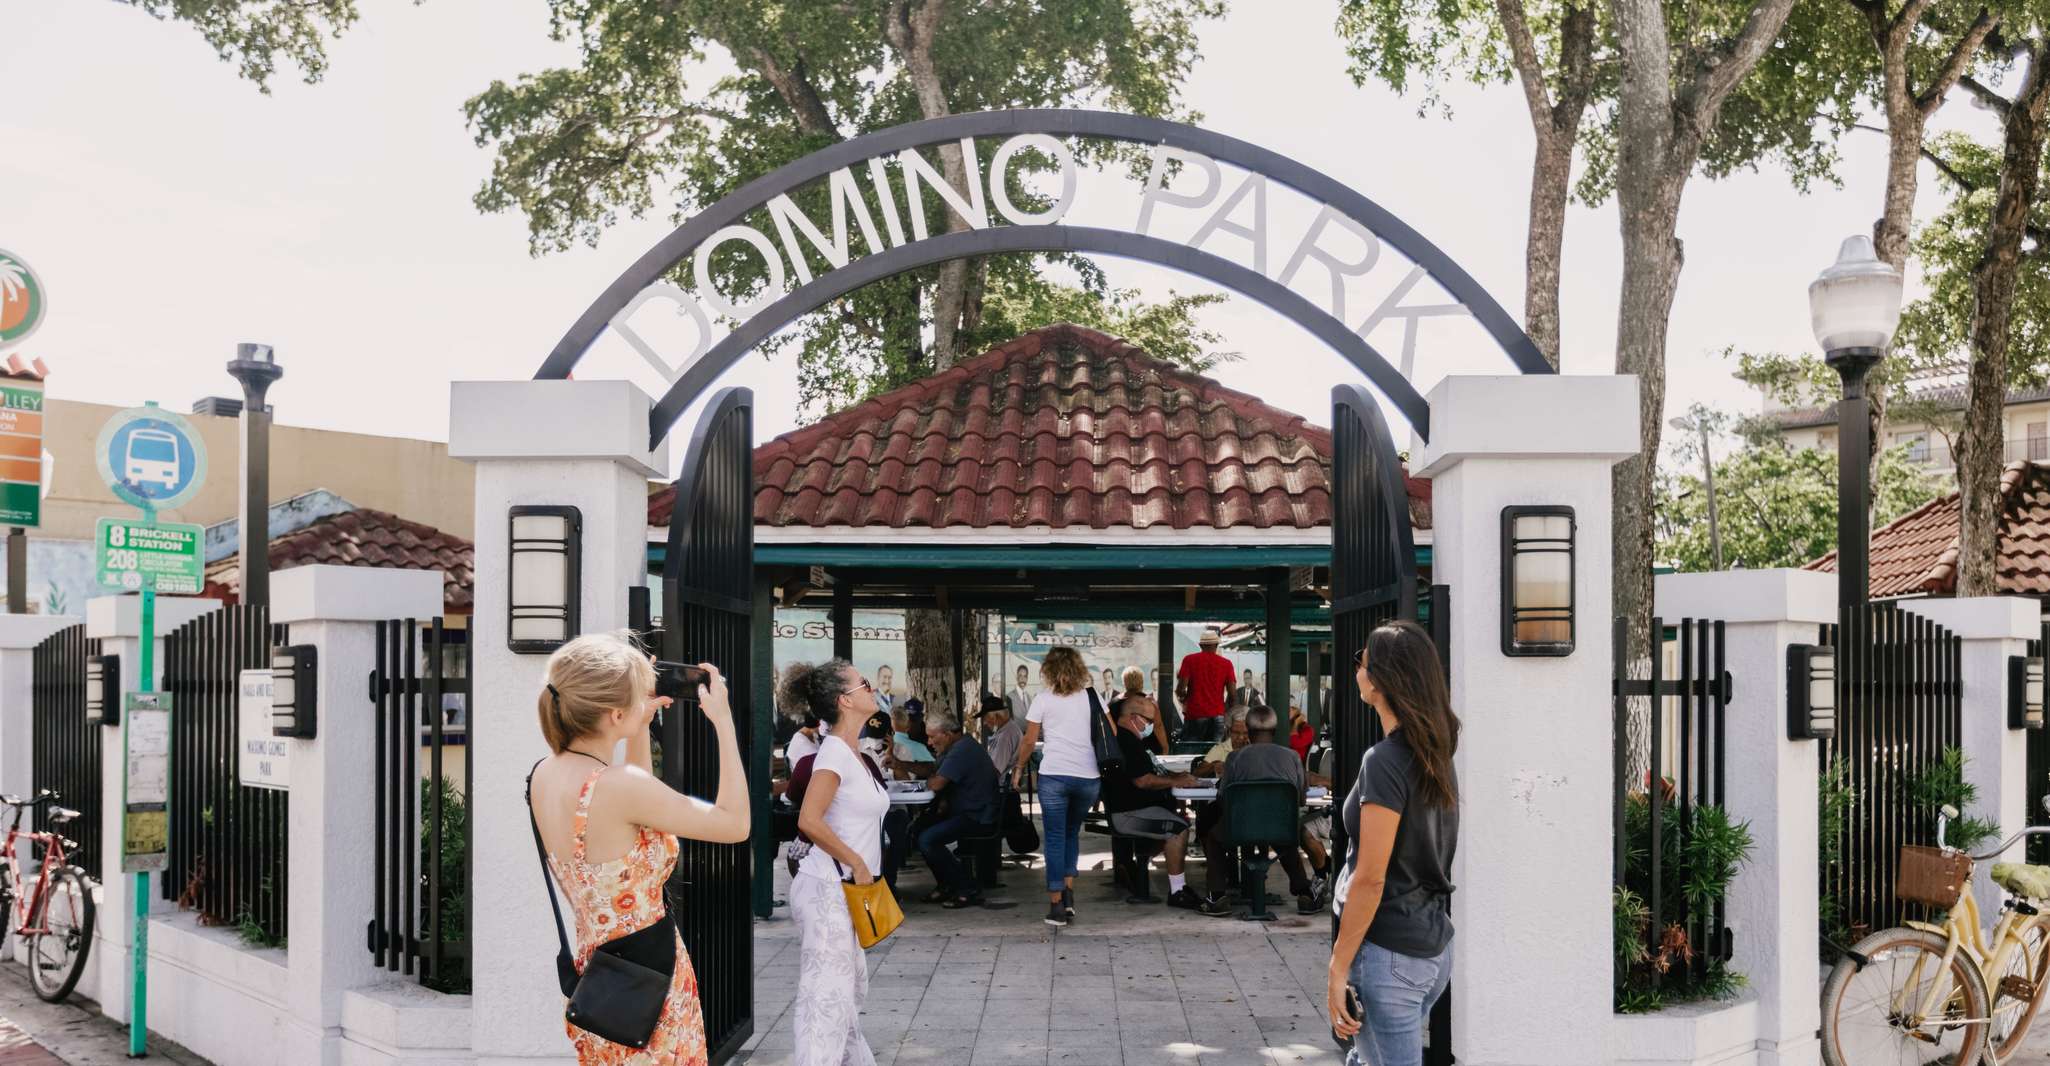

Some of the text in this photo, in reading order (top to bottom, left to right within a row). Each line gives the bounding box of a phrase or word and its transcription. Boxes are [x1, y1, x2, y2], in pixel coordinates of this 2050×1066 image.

[609, 132, 1474, 386] DOMINO PARK
[110, 526, 126, 546] 8
[129, 527, 192, 541] BRICKELL
[129, 538, 183, 551] STATION
[107, 549, 138, 570] 208
[1016, 630, 1135, 649] Americas
